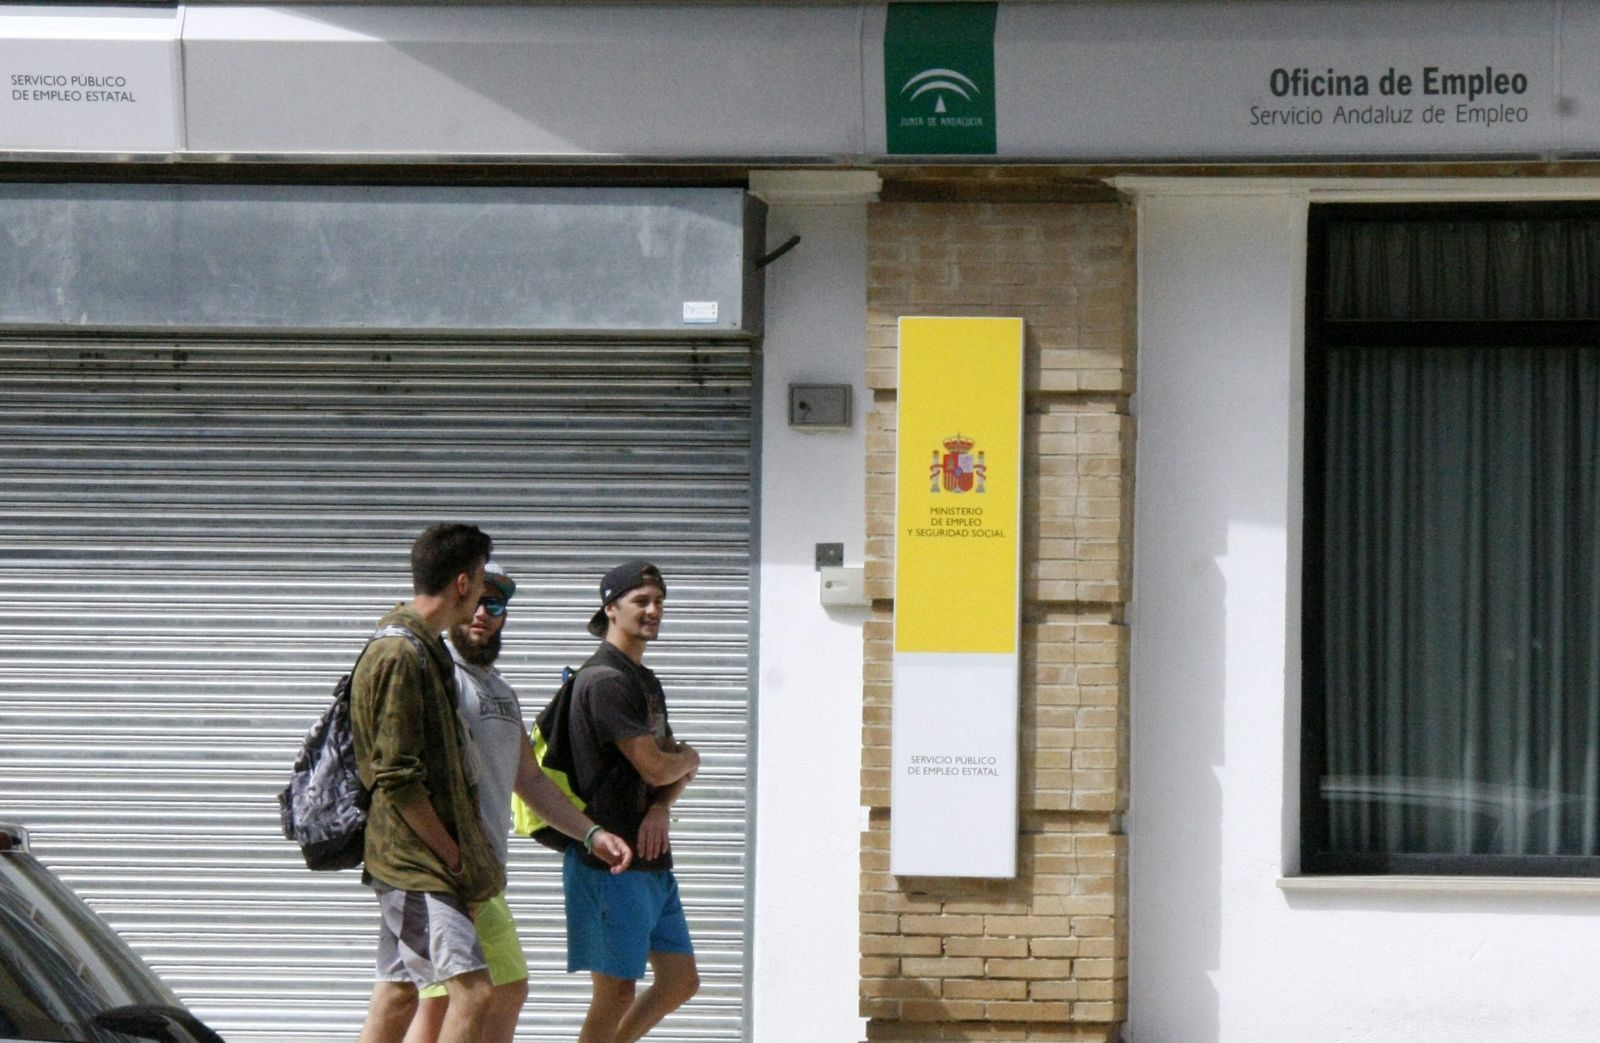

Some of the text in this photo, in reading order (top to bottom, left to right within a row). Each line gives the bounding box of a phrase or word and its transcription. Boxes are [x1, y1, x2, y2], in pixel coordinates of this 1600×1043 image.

[11, 73, 126, 88] SERVICIO PÚBLICO
[1270, 66, 1528, 101] Oficina de Empleo
[12, 89, 136, 103] DE EMPLEO ESTATAL
[1250, 103, 1528, 127] Servicio Andaluz de Empleo
[930, 507, 983, 516] MINISTERIO
[931, 517, 982, 527] DE EMPLEO
[907, 528, 1005, 538] Y SEGURIDAD SOCIAL
[911, 754, 997, 765] SERVICIO PÚBLICO
[908, 766, 999, 776] DE EMPLEO ESTATAL
